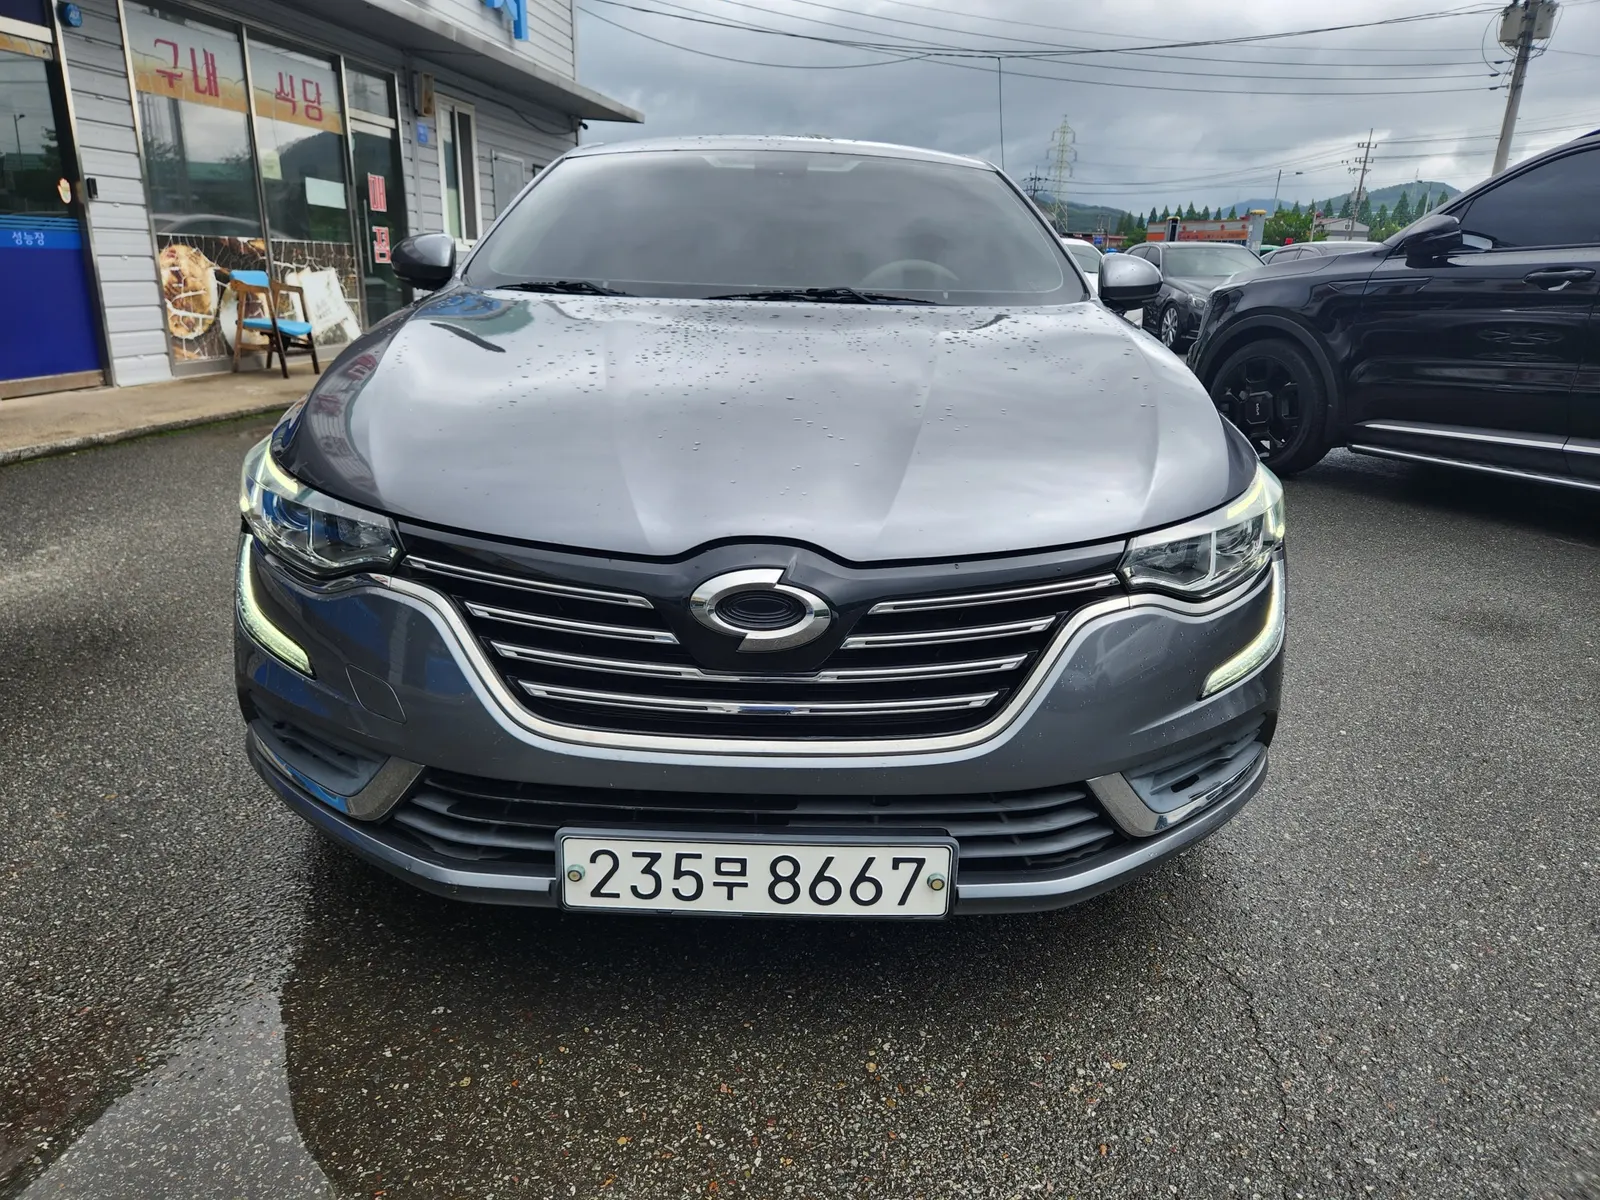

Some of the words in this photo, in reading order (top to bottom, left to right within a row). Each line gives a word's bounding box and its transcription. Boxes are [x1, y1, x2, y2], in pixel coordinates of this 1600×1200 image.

[154, 38, 219, 98] 구내
[275, 71, 323, 122] 식당
[12, 231, 45, 246] 성능장
[589, 848, 749, 902] 235무
[767, 854, 926, 907] 8667
